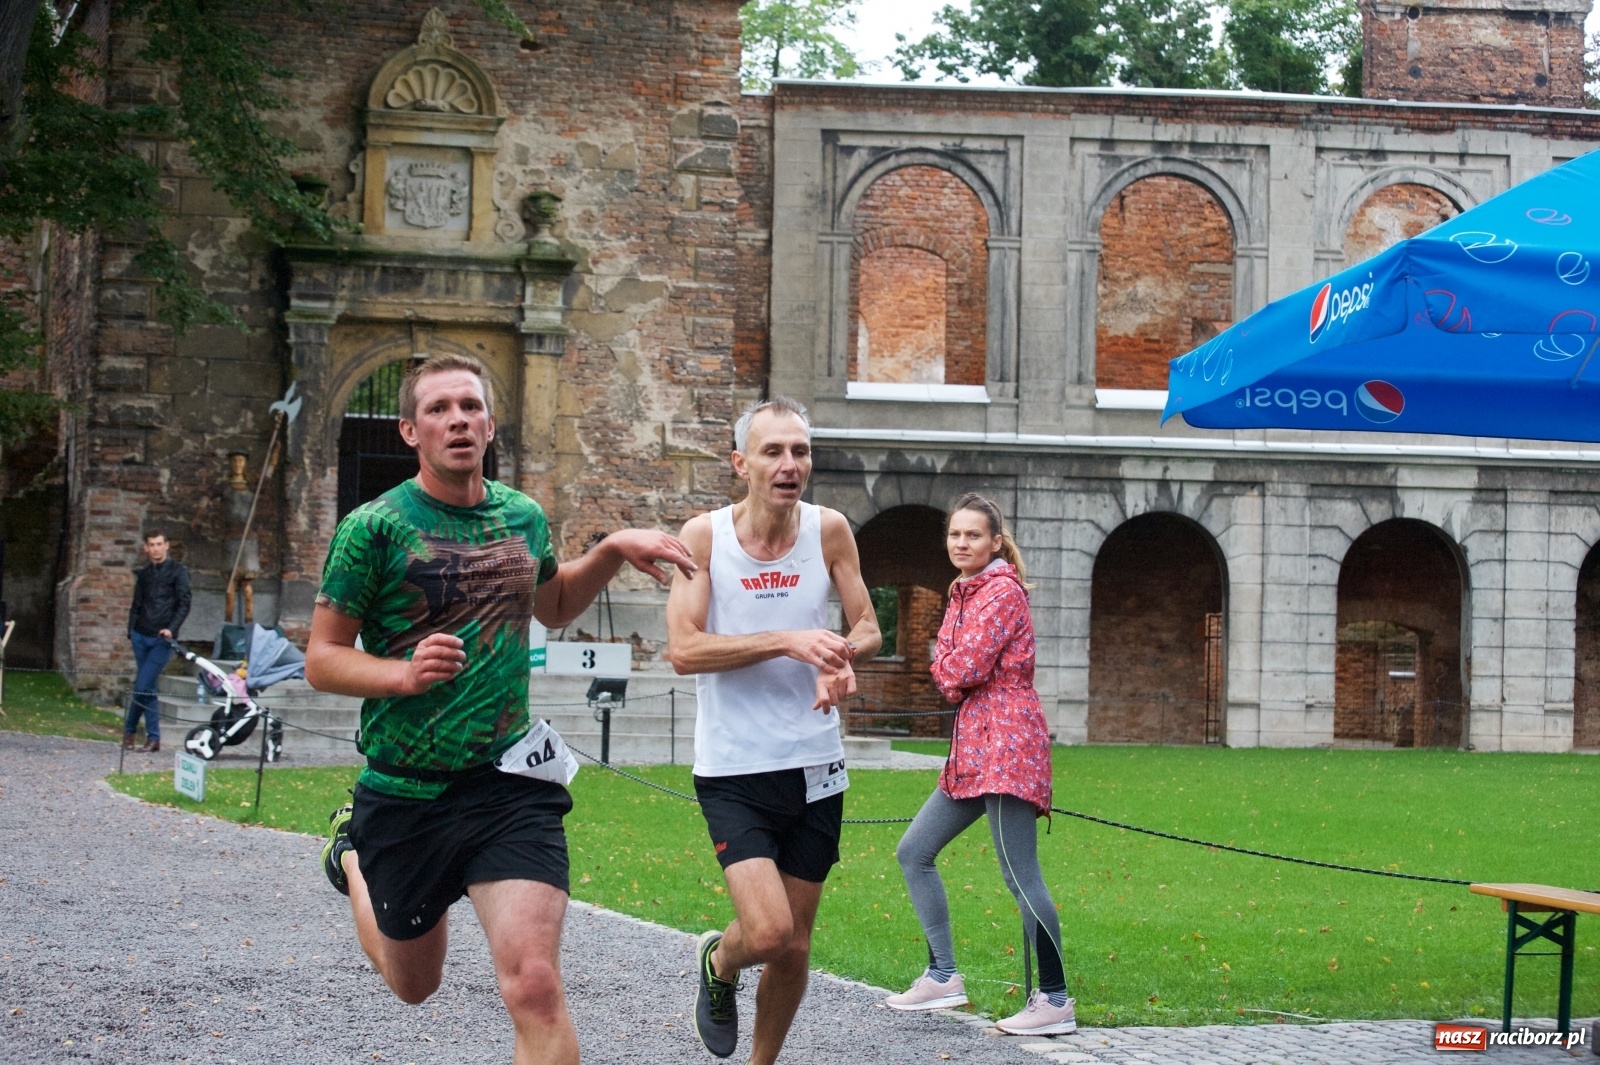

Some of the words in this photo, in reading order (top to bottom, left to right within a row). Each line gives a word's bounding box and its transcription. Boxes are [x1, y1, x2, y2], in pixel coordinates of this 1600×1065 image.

[1327, 272, 1374, 331] pepsi
[740, 571, 800, 590] RAFAKO
[755, 592, 775, 600] GRUPA
[582, 649, 596, 669] 3
